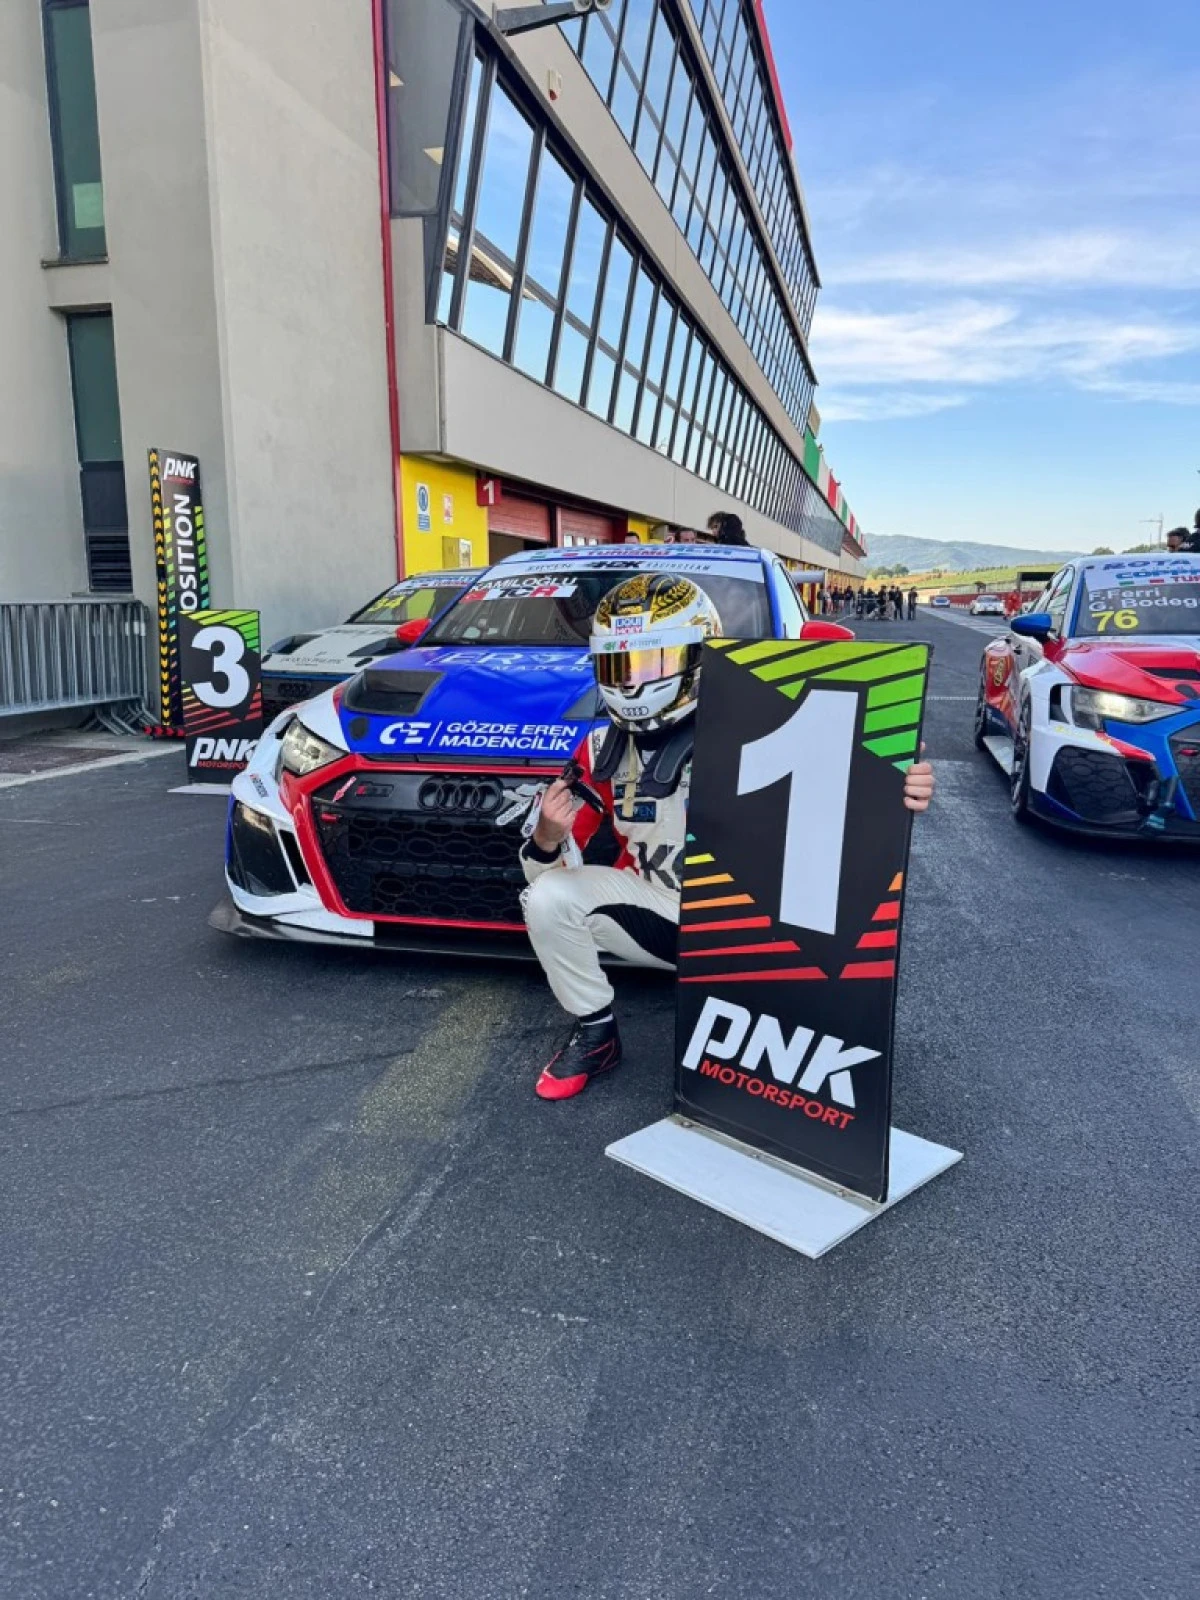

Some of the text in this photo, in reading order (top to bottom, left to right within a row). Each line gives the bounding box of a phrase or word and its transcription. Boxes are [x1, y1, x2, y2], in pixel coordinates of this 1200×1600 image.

[163, 457, 198, 480] PNK
[482, 480, 495, 505] 1
[173, 494, 198, 612] OSITION
[1121, 597, 1200, 609] Bodeg
[1091, 609, 1139, 632] 76
[191, 625, 250, 709] 3
[446, 720, 518, 735] GÖZDE
[521, 724, 579, 737] EREN
[439, 735, 572, 751] MADENCİLİK
[737, 688, 858, 935] 1
[681, 996, 883, 1109] PNK
[700, 1058, 856, 1129] MOTORSPORT
